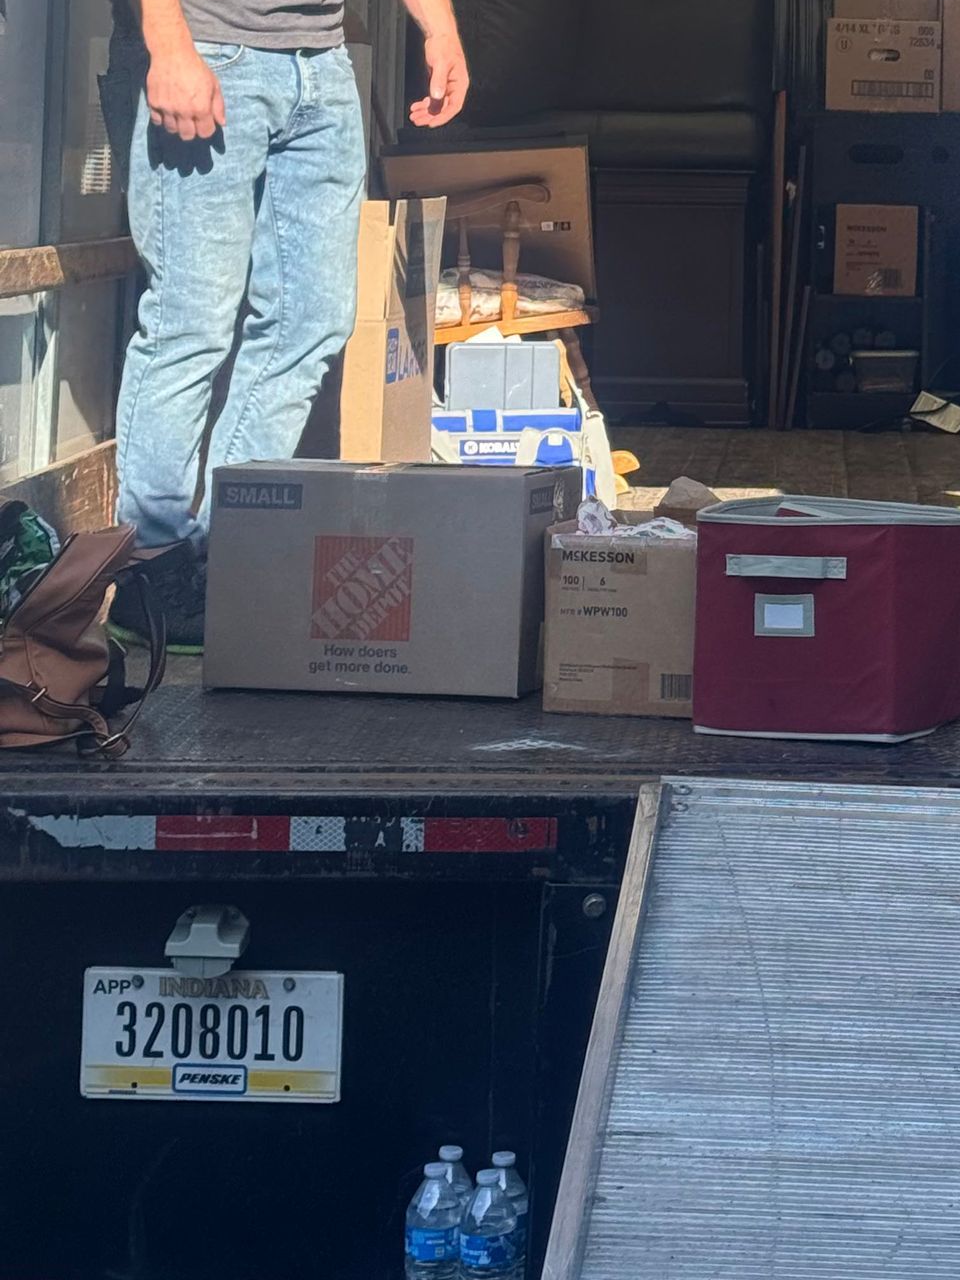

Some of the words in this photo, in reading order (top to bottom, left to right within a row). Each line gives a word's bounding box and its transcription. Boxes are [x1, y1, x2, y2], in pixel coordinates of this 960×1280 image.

[225, 485, 295, 505] SMALL
[326, 551, 362, 587] THE
[312, 536, 412, 639] HOME
[563, 575, 579, 585] 100
[599, 576, 606, 586] 6
[348, 576, 412, 641] DEPOT
[583, 606, 628, 618] WPW100
[323, 644, 355, 657] How
[358, 645, 397, 658] doers
[308, 661, 331, 674] get
[334, 663, 370, 673] more
[374, 661, 411, 674] done.
[93, 979, 131, 995] APP
[159, 976, 270, 1000] INDIANA
[115, 1001, 304, 1062] 3208010
[178, 1073, 241, 1085] PENSKE
